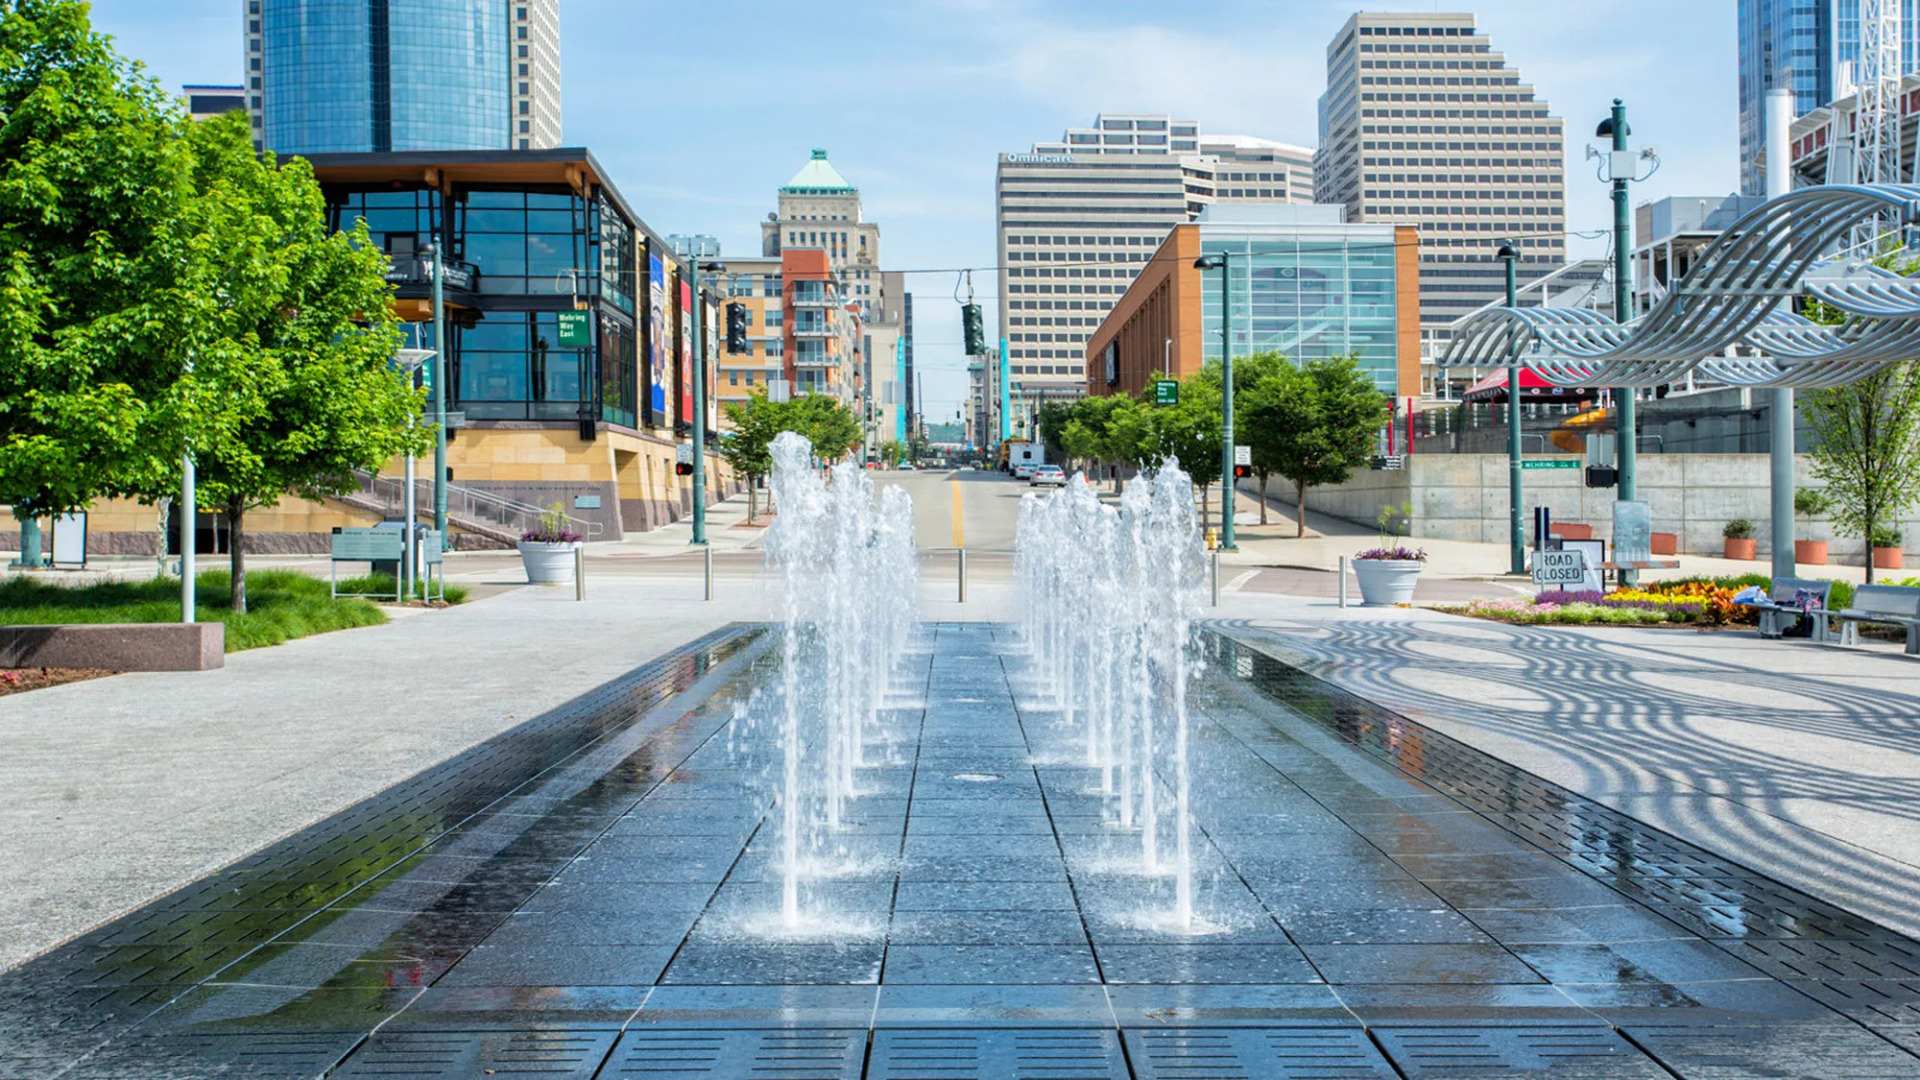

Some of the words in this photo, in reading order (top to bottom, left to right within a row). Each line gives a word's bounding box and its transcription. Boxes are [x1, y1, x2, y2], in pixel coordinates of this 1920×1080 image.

[1007, 152, 1075, 163] Omnicare
[559, 314, 586, 322] Mehring
[560, 322, 574, 330] Way
[559, 330, 575, 338] East
[1536, 568, 1580, 580] CLOSED
